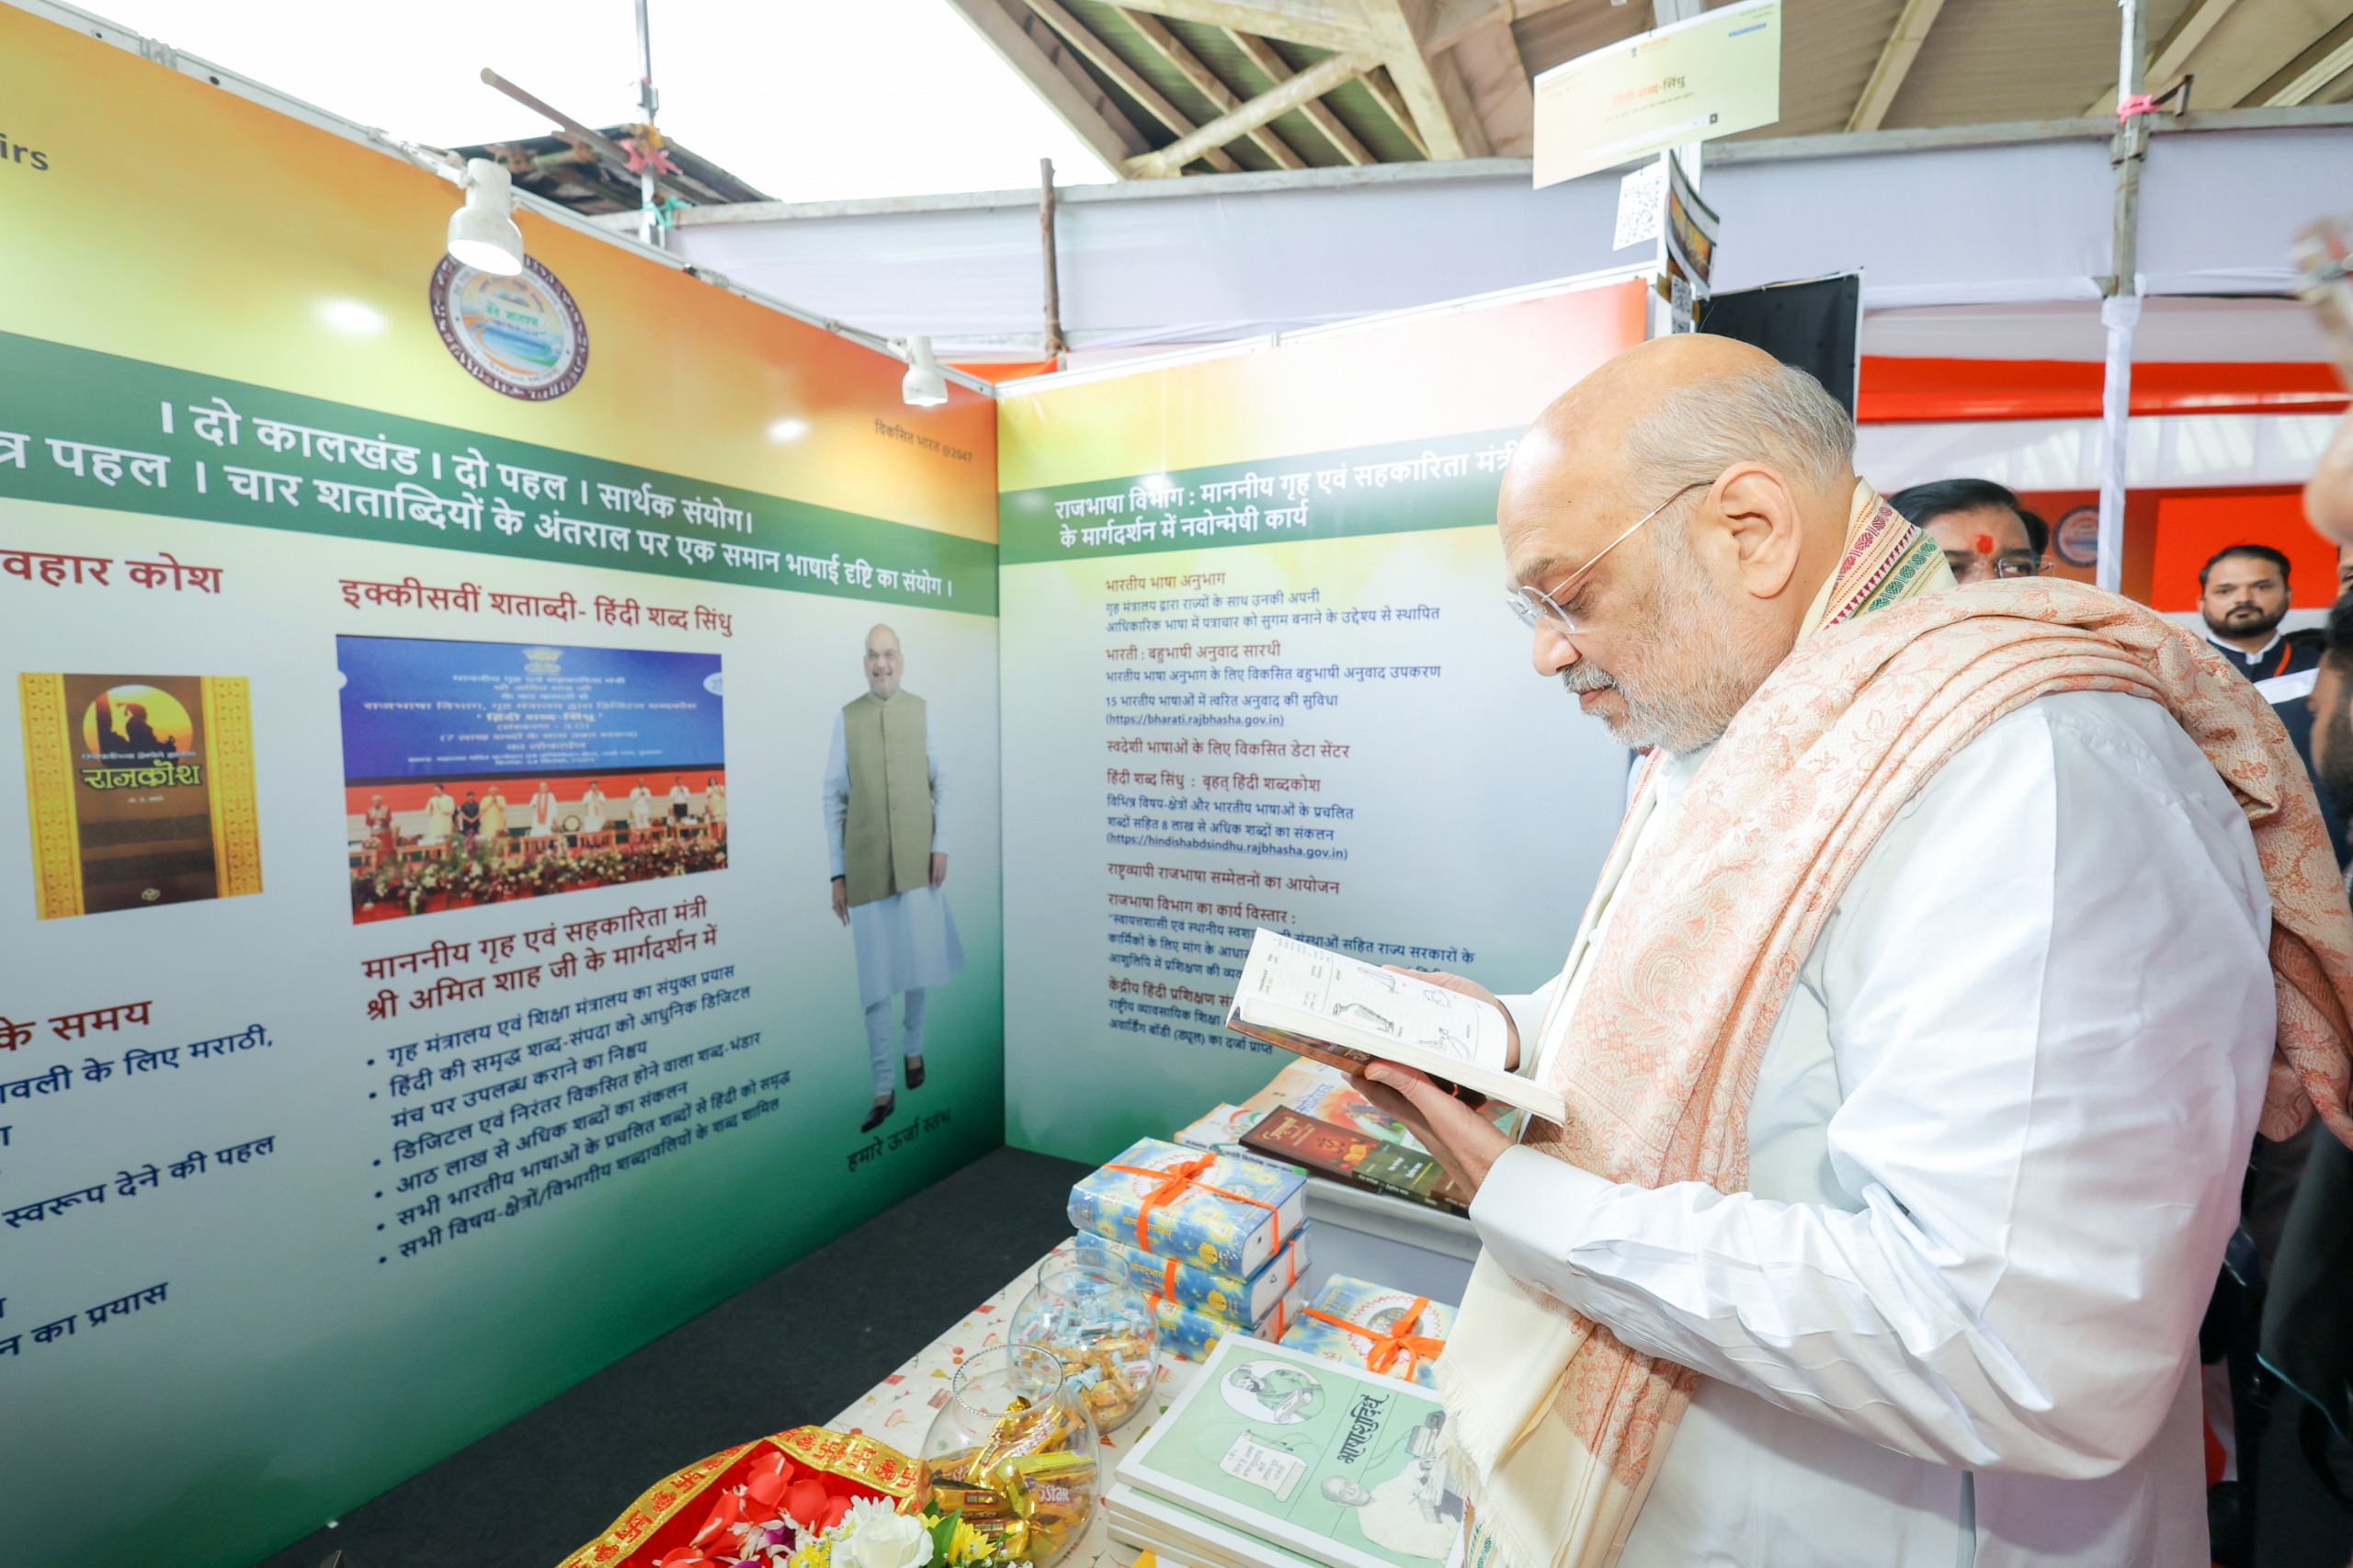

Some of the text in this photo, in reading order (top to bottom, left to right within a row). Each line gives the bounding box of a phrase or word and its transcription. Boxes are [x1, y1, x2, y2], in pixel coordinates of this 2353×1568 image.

[874, 417, 915, 445] विकसित
[917, 436, 939, 452] भारत
[188, 397, 752, 533] दो कालखंड दो पहल सार्थक संयोग।
[1054, 494, 1124, 518] राजभाषा
[1199, 474, 1274, 502] माननीय
[1279, 473, 1309, 498] गृह
[1317, 461, 1348, 494] एवं
[1354, 449, 1469, 488] सहकारिता
[44, 437, 171, 487] पहल
[222, 465, 302, 506] चार
[313, 479, 483, 530] शताब्दियों
[491, 496, 526, 535] के
[534, 509, 631, 551] अंतराल
[636, 529, 670, 557] पर
[675, 536, 716, 564] एक
[721, 543, 779, 572] समान
[785, 553, 839, 585] भाषाई
[843, 558, 872, 587] दृष्टि
[876, 568, 898, 588] का
[902, 569, 941, 595] संयोग
[1059, 499, 1309, 547] के मार्गदर्शन में नवोन्मेषी कार्य
[124, 552, 223, 594] कोश
[1106, 573, 1225, 591] भारतीय भाषा अनुभाग
[338, 577, 732, 637] इक्कीसवीं शताब्दी- हिंदी शब्द सिंधु
[1106, 639, 1280, 663] भारती बहुभाषी अनुवाद सारथी
[1106, 712, 1285, 729] (https://bharati.rajbhasha.gov.in)
[1107, 738, 1349, 757] स्वदेशी भाषाओं के लिए विकसित डेटा सेंटर
[1107, 769, 1130, 784] हिंदी
[1133, 773, 1156, 786] शब्द
[1160, 770, 1184, 790] सिंधु
[1233, 772, 1258, 790] हिंदी
[1263, 774, 1321, 791] शब्दकोश
[1107, 833, 1348, 859] (https://hindishabdsindhu.rajbhasha.gov.in)
[361, 895, 707, 978] माननीय गृह एवं सहकारिता मंत्री
[1108, 893, 1288, 923] राजभाषा विभाग का कार्य विस्तार
[367, 924, 717, 1020] श्री अमित शाह जी के मार्गदर्शन में
[48, 1001, 152, 1040] समय
[387, 965, 733, 1063] गृह मंत्रालय एवं शिक्षा मंत्रालय का संयुक्त प्रयास
[389, 986, 750, 1096] हिंदी की समृद्ध शब्द-संपदा को आधुनिक डिजिटल
[81, 1057, 114, 1082] के
[123, 1047, 179, 1074] लिए
[188, 1024, 272, 1058] मराठी,
[391, 1040, 647, 1127] मंच पर उपलब्ध कराने का निश्चय
[392, 1032, 760, 1162] डिजिटल एवं निरंतर विकसित होने वाला शब्द-भंडार
[847, 1136, 884, 1172] हमारे
[888, 1117, 919, 1151] ऊर्जा
[2, 1135, 275, 1228] स्वरूप देने की पहल
[30, 1314, 76, 1342] का
[85, 1282, 167, 1326] प्रयास
